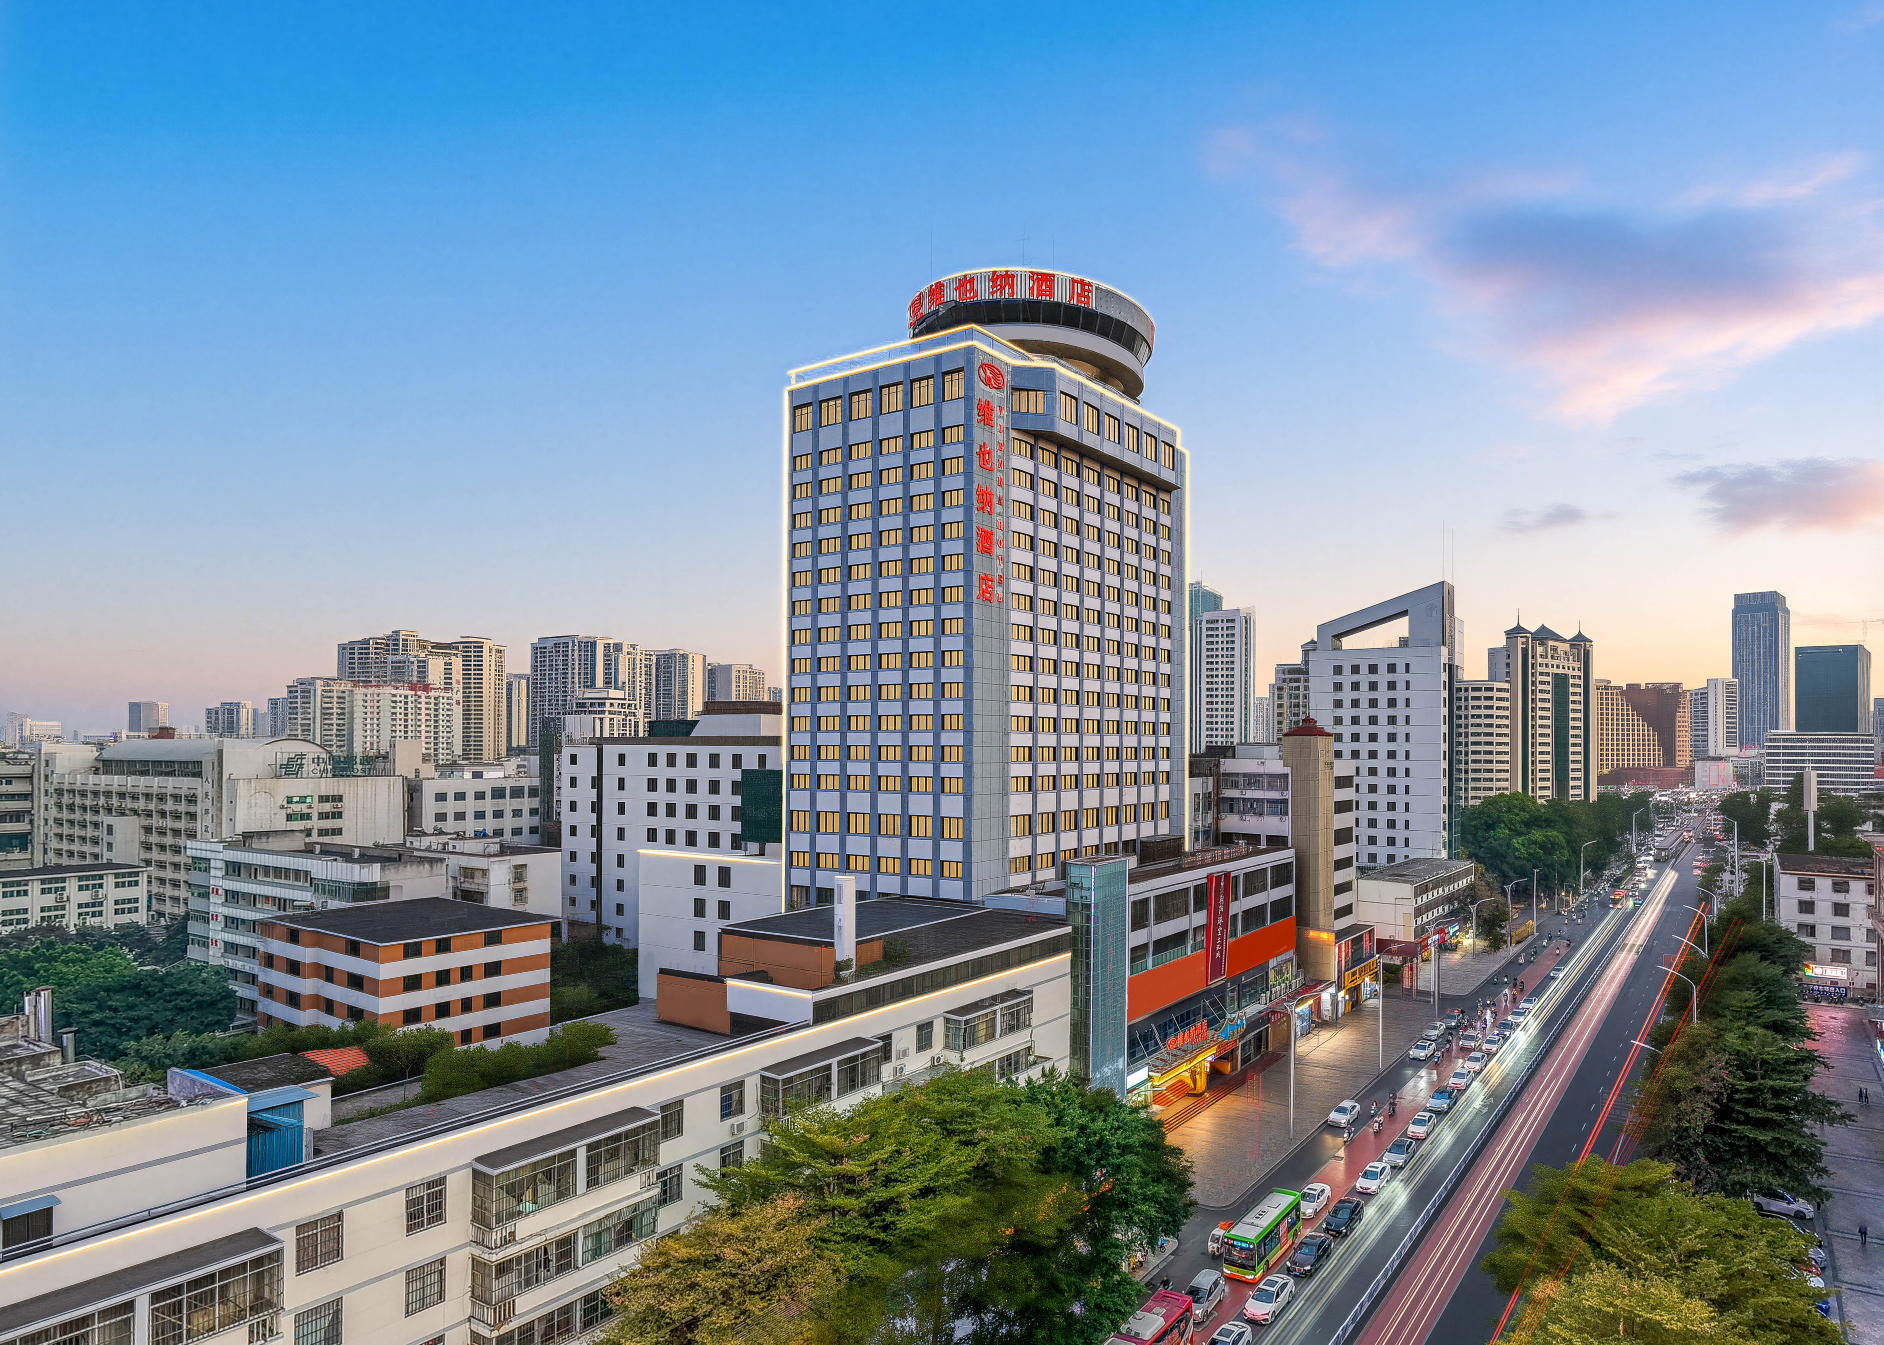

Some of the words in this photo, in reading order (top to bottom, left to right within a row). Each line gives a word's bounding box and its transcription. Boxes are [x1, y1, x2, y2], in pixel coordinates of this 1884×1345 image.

[928, 269, 1093, 308] 维也纳酒店
[976, 397, 995, 604] 维也纳酒店
